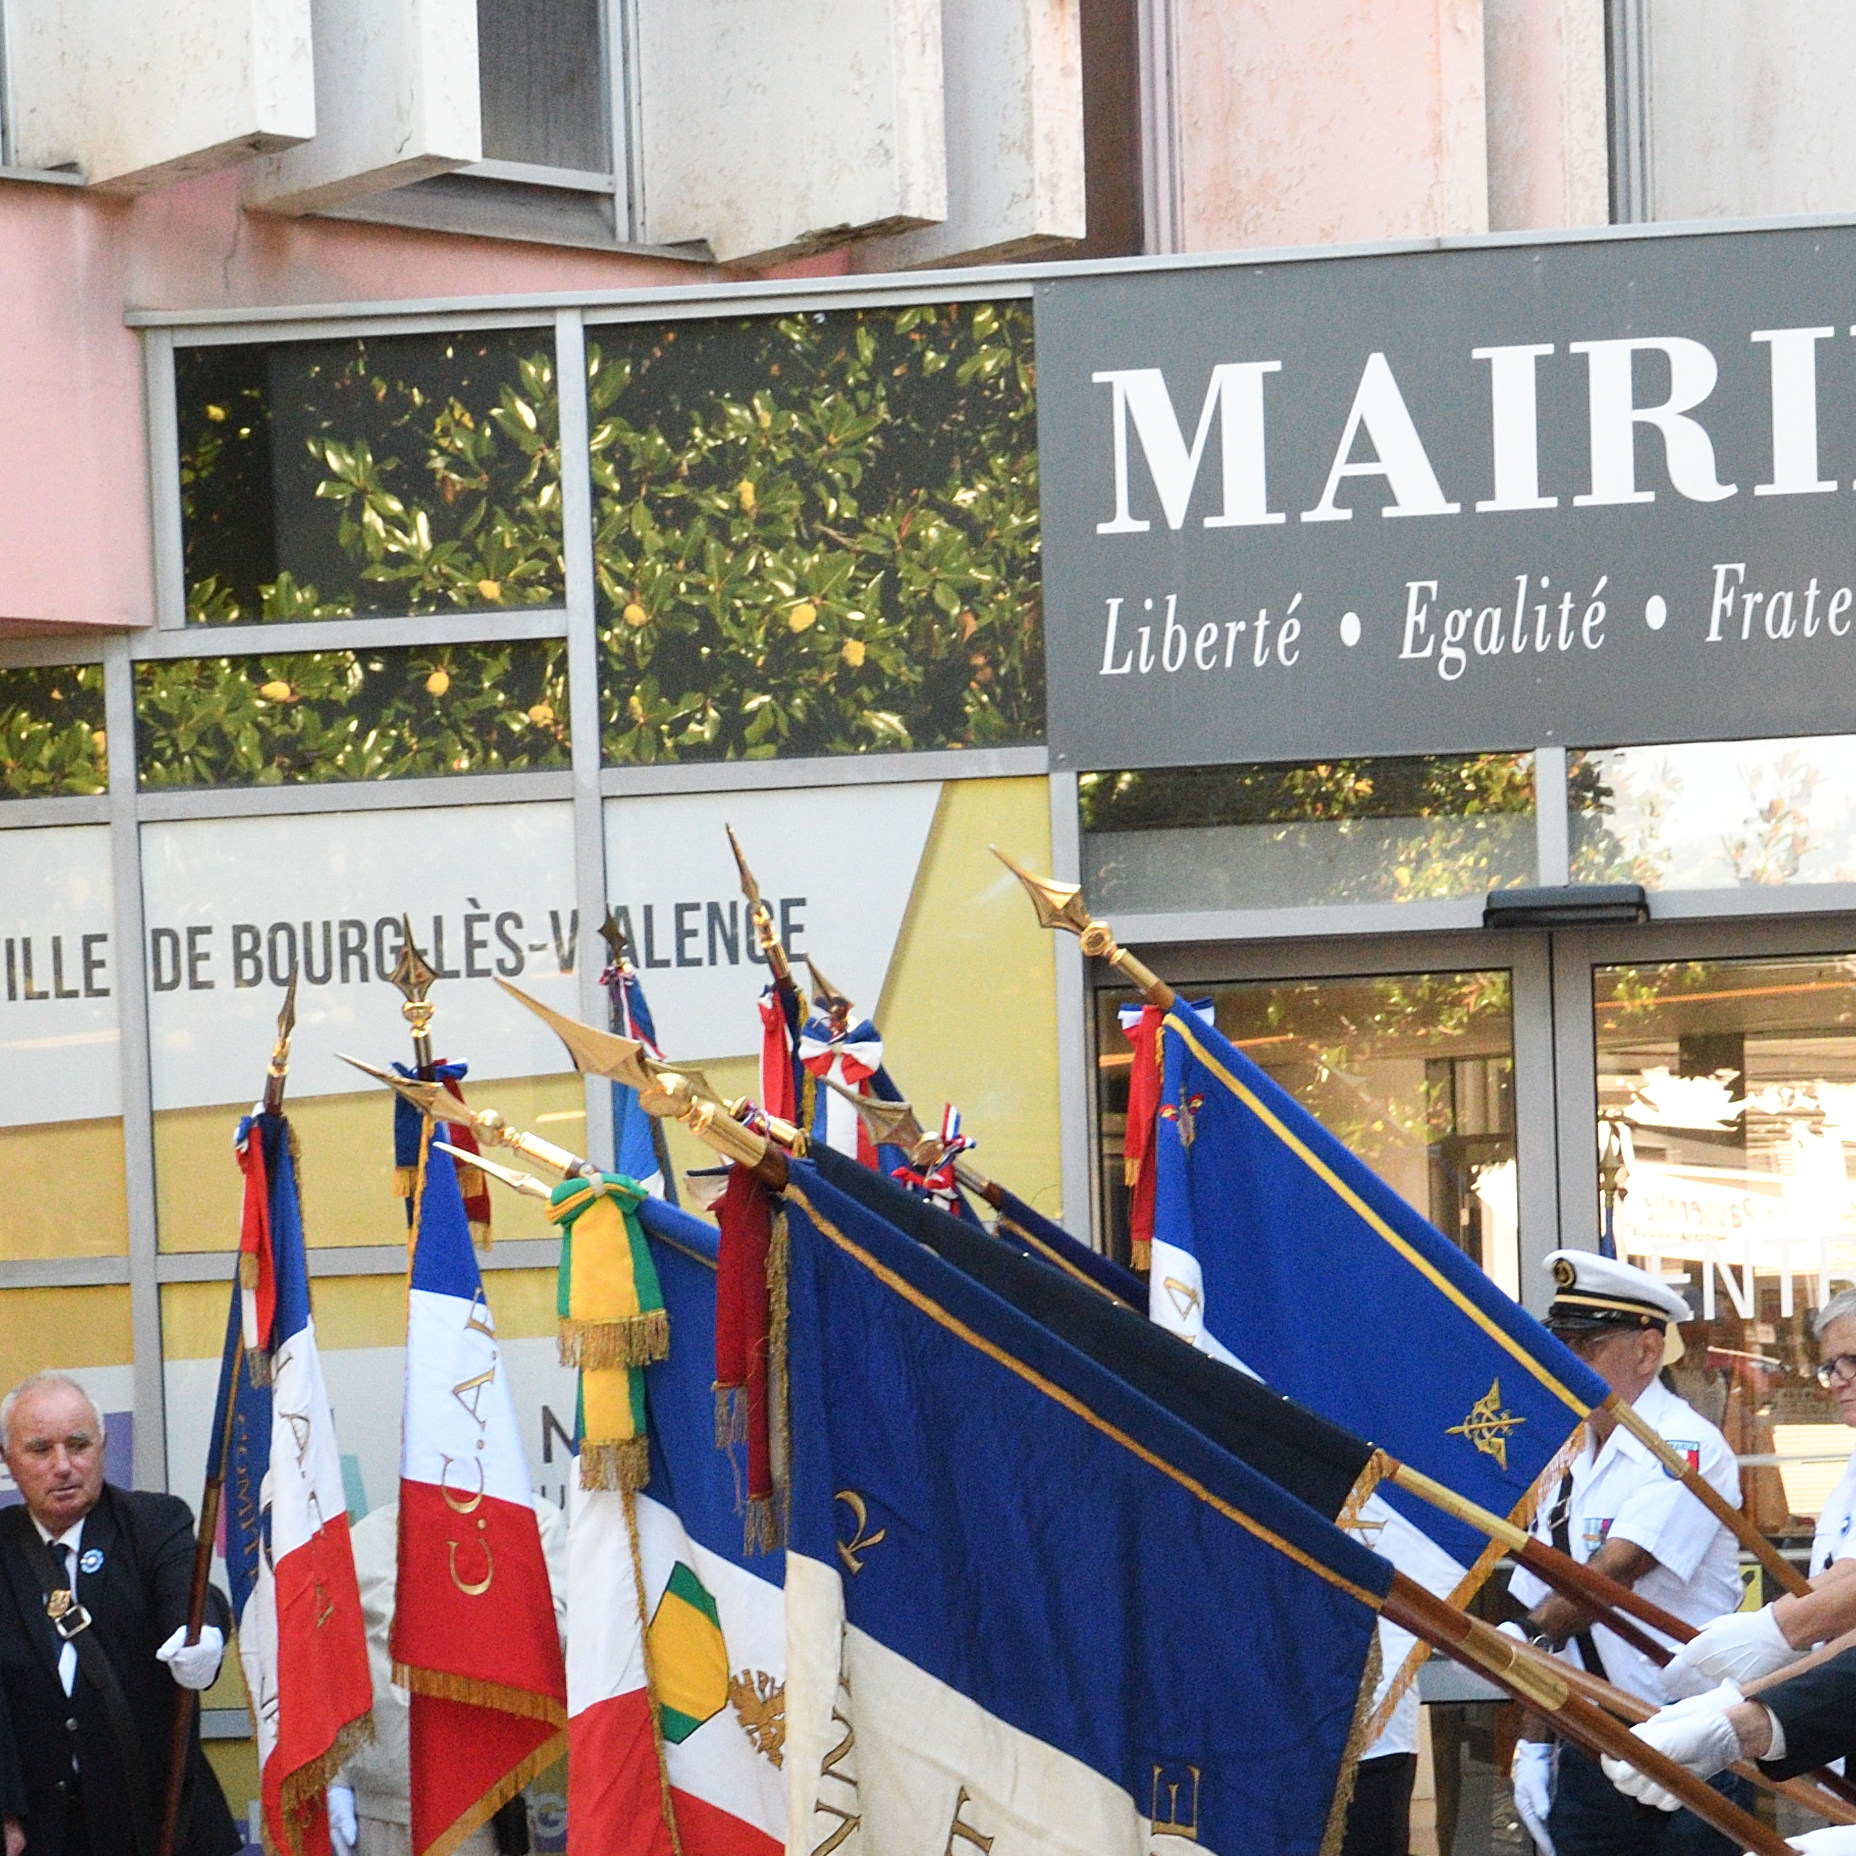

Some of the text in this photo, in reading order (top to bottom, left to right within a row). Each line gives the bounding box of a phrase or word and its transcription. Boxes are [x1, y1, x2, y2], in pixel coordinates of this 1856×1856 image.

[1098, 591, 1304, 677] Liberté
[1398, 574, 1610, 682] Egalité
[150, 925, 215, 993] DE
